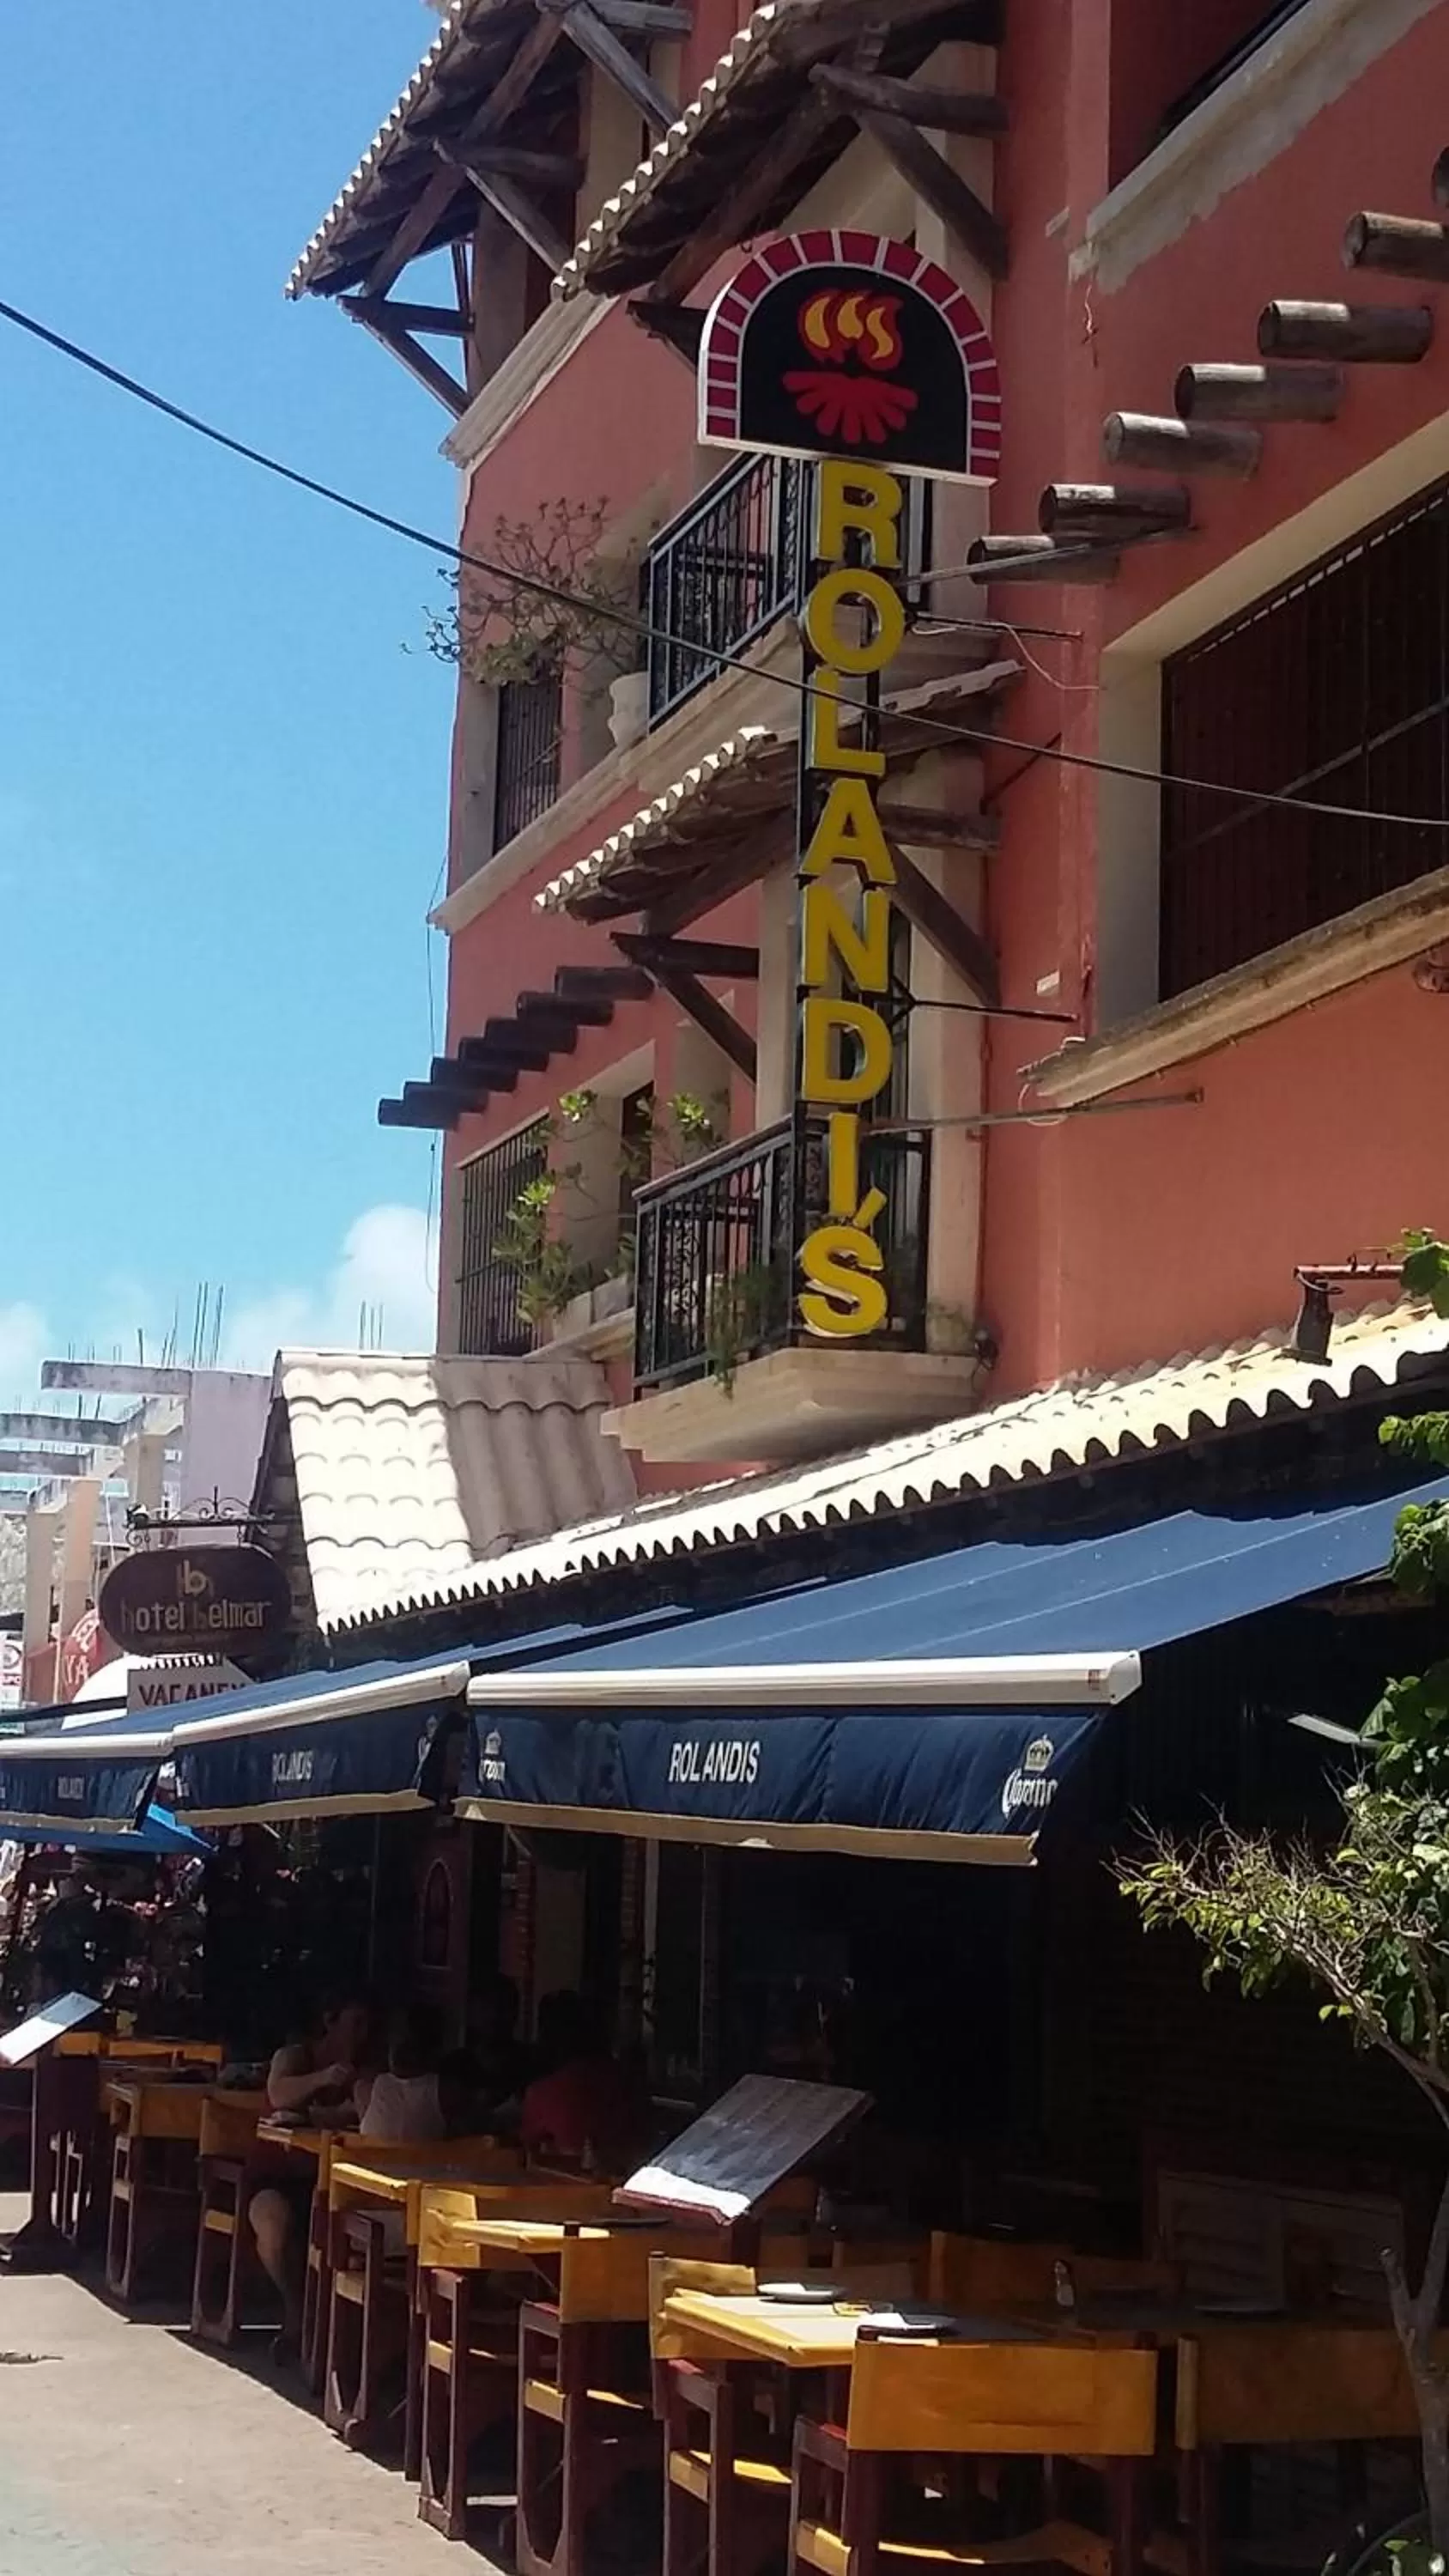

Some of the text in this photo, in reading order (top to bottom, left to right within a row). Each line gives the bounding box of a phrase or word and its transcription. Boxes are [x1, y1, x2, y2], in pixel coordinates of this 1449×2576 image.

[120, 1598, 185, 1632] hotel
[191, 1598, 271, 1630] belmar
[669, 1741, 761, 1783] ROLANDIS
